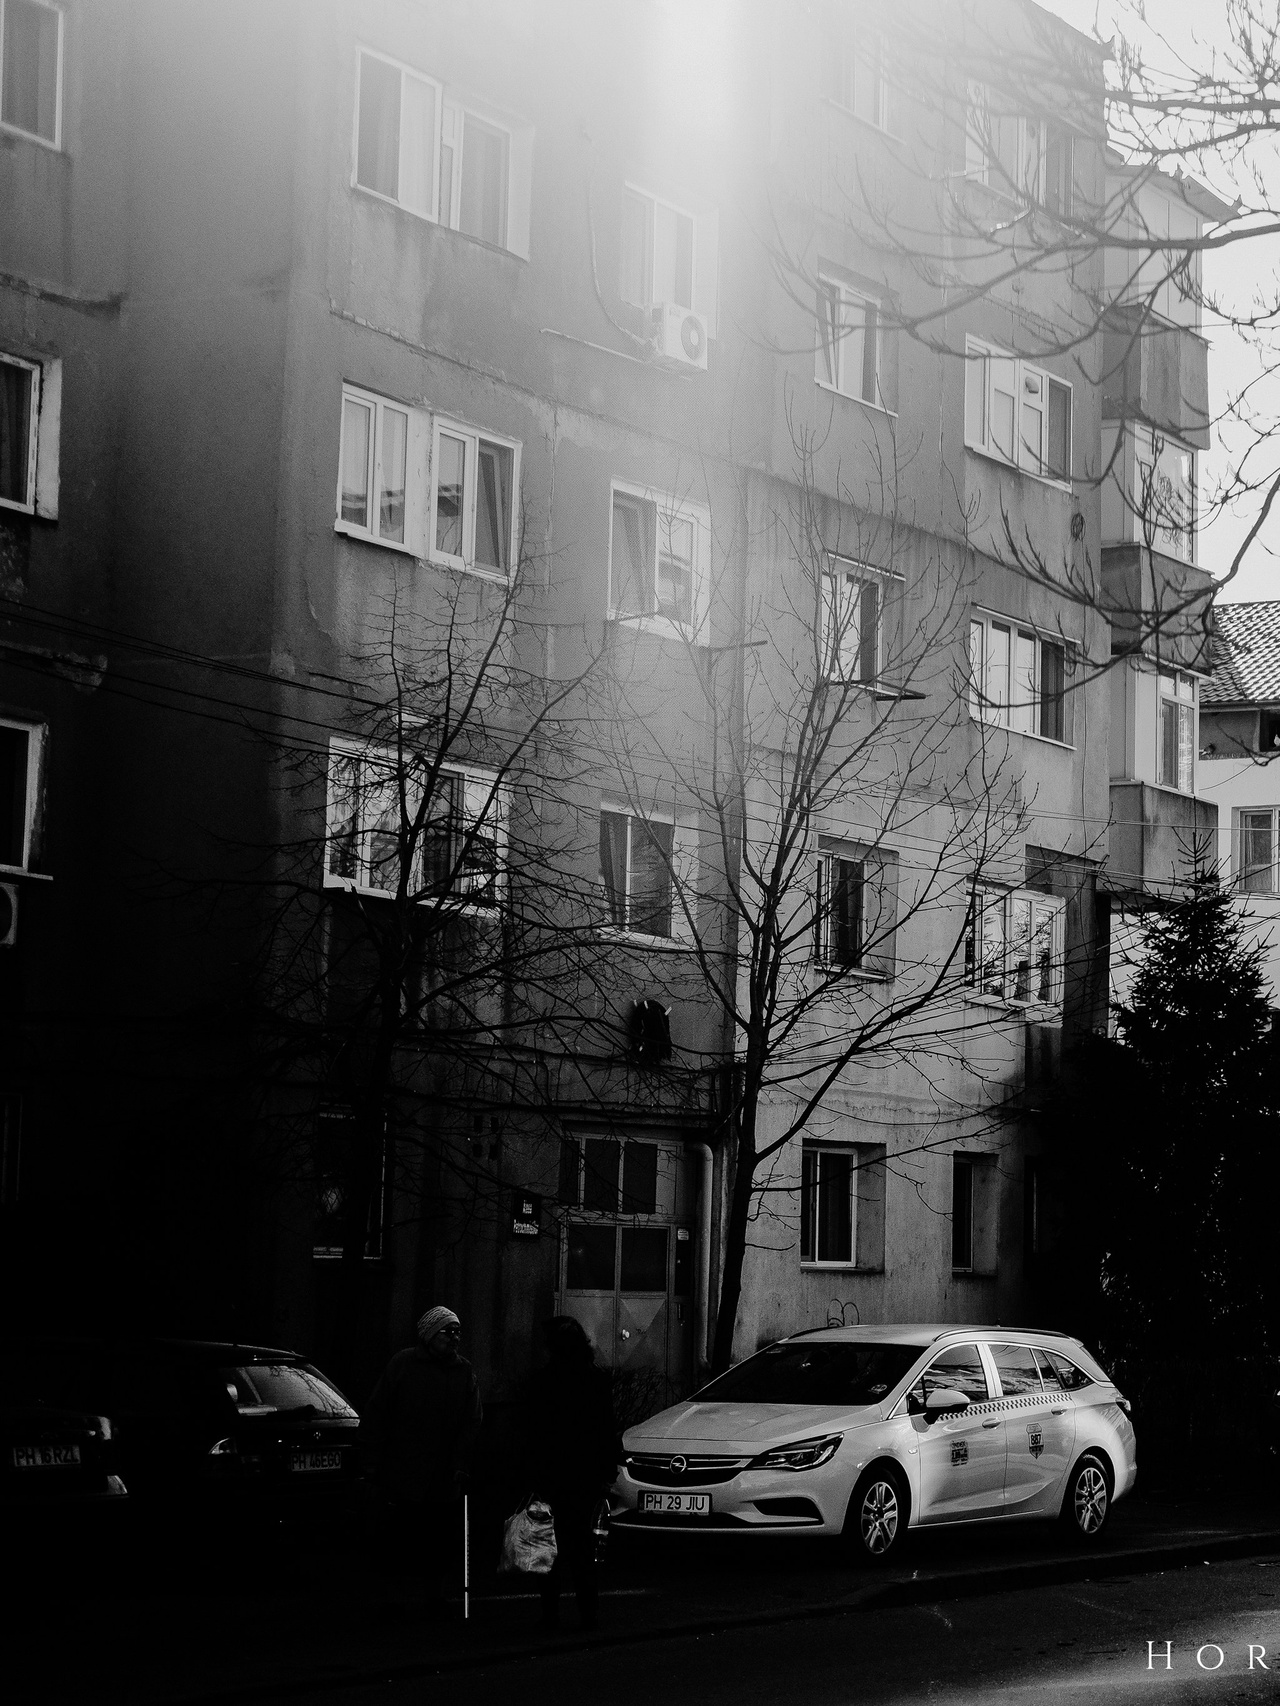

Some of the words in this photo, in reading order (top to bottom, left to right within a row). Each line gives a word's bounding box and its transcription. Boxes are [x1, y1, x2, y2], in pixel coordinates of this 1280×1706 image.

[16, 1447, 36, 1465] PH
[292, 1454, 306, 1469] PH
[645, 1494, 663, 1509] PH
[666, 1495, 682, 1510] 29
[685, 1496, 705, 1511] JIU
